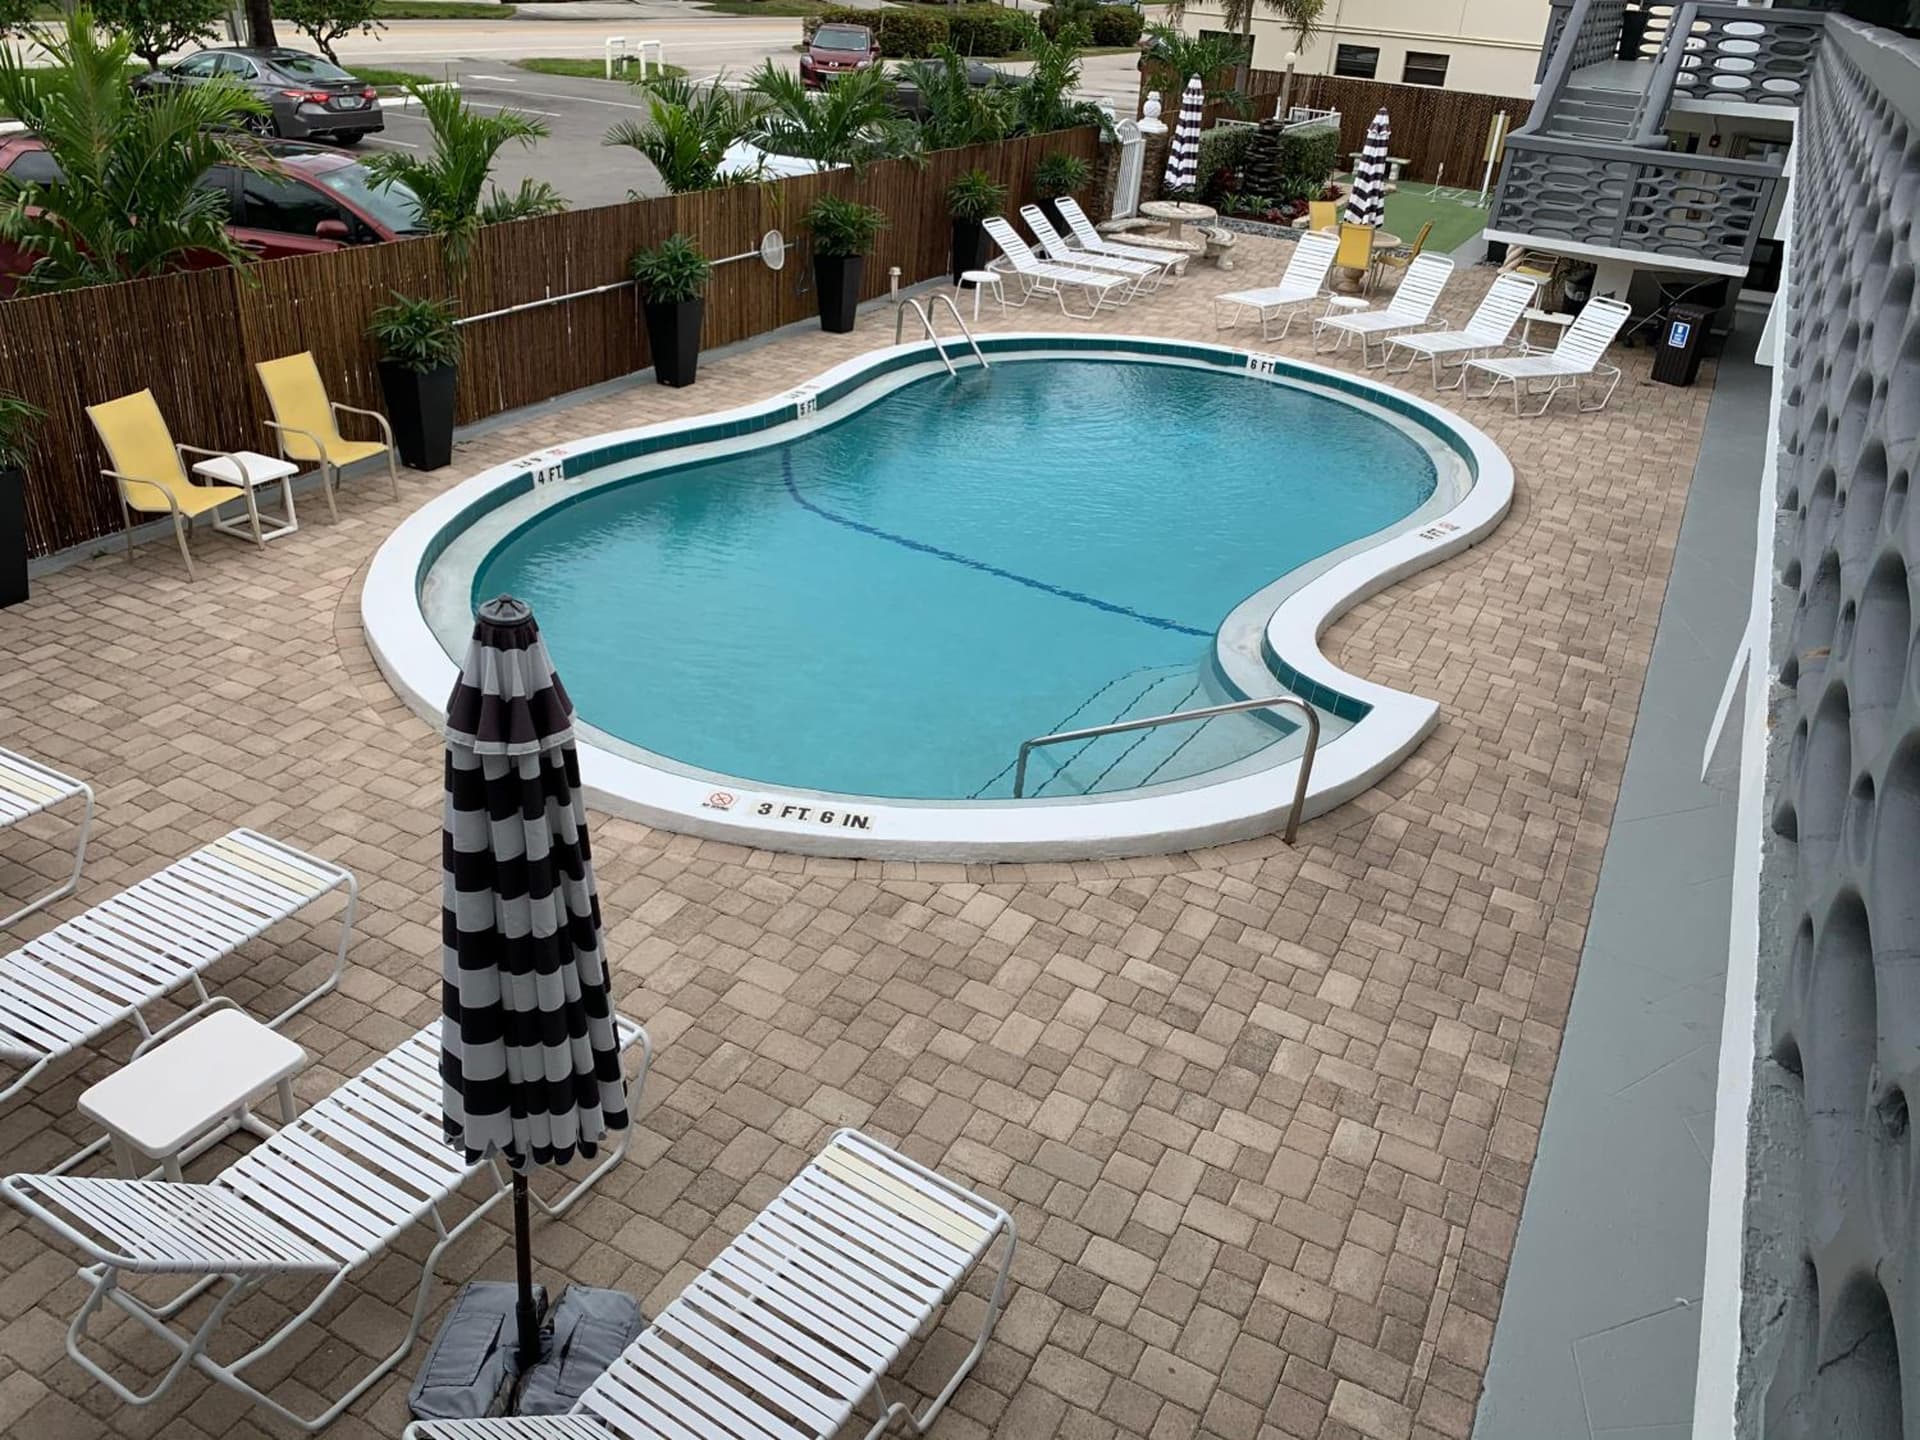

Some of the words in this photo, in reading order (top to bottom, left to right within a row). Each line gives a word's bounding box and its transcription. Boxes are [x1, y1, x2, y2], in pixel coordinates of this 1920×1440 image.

[1250, 359, 1258, 370] 6
[538, 470, 545, 485] 4
[757, 803, 773, 815] 3
[781, 806, 811, 821] FT.
[820, 811, 835, 824] 6
[842, 814, 870, 830] IN.
